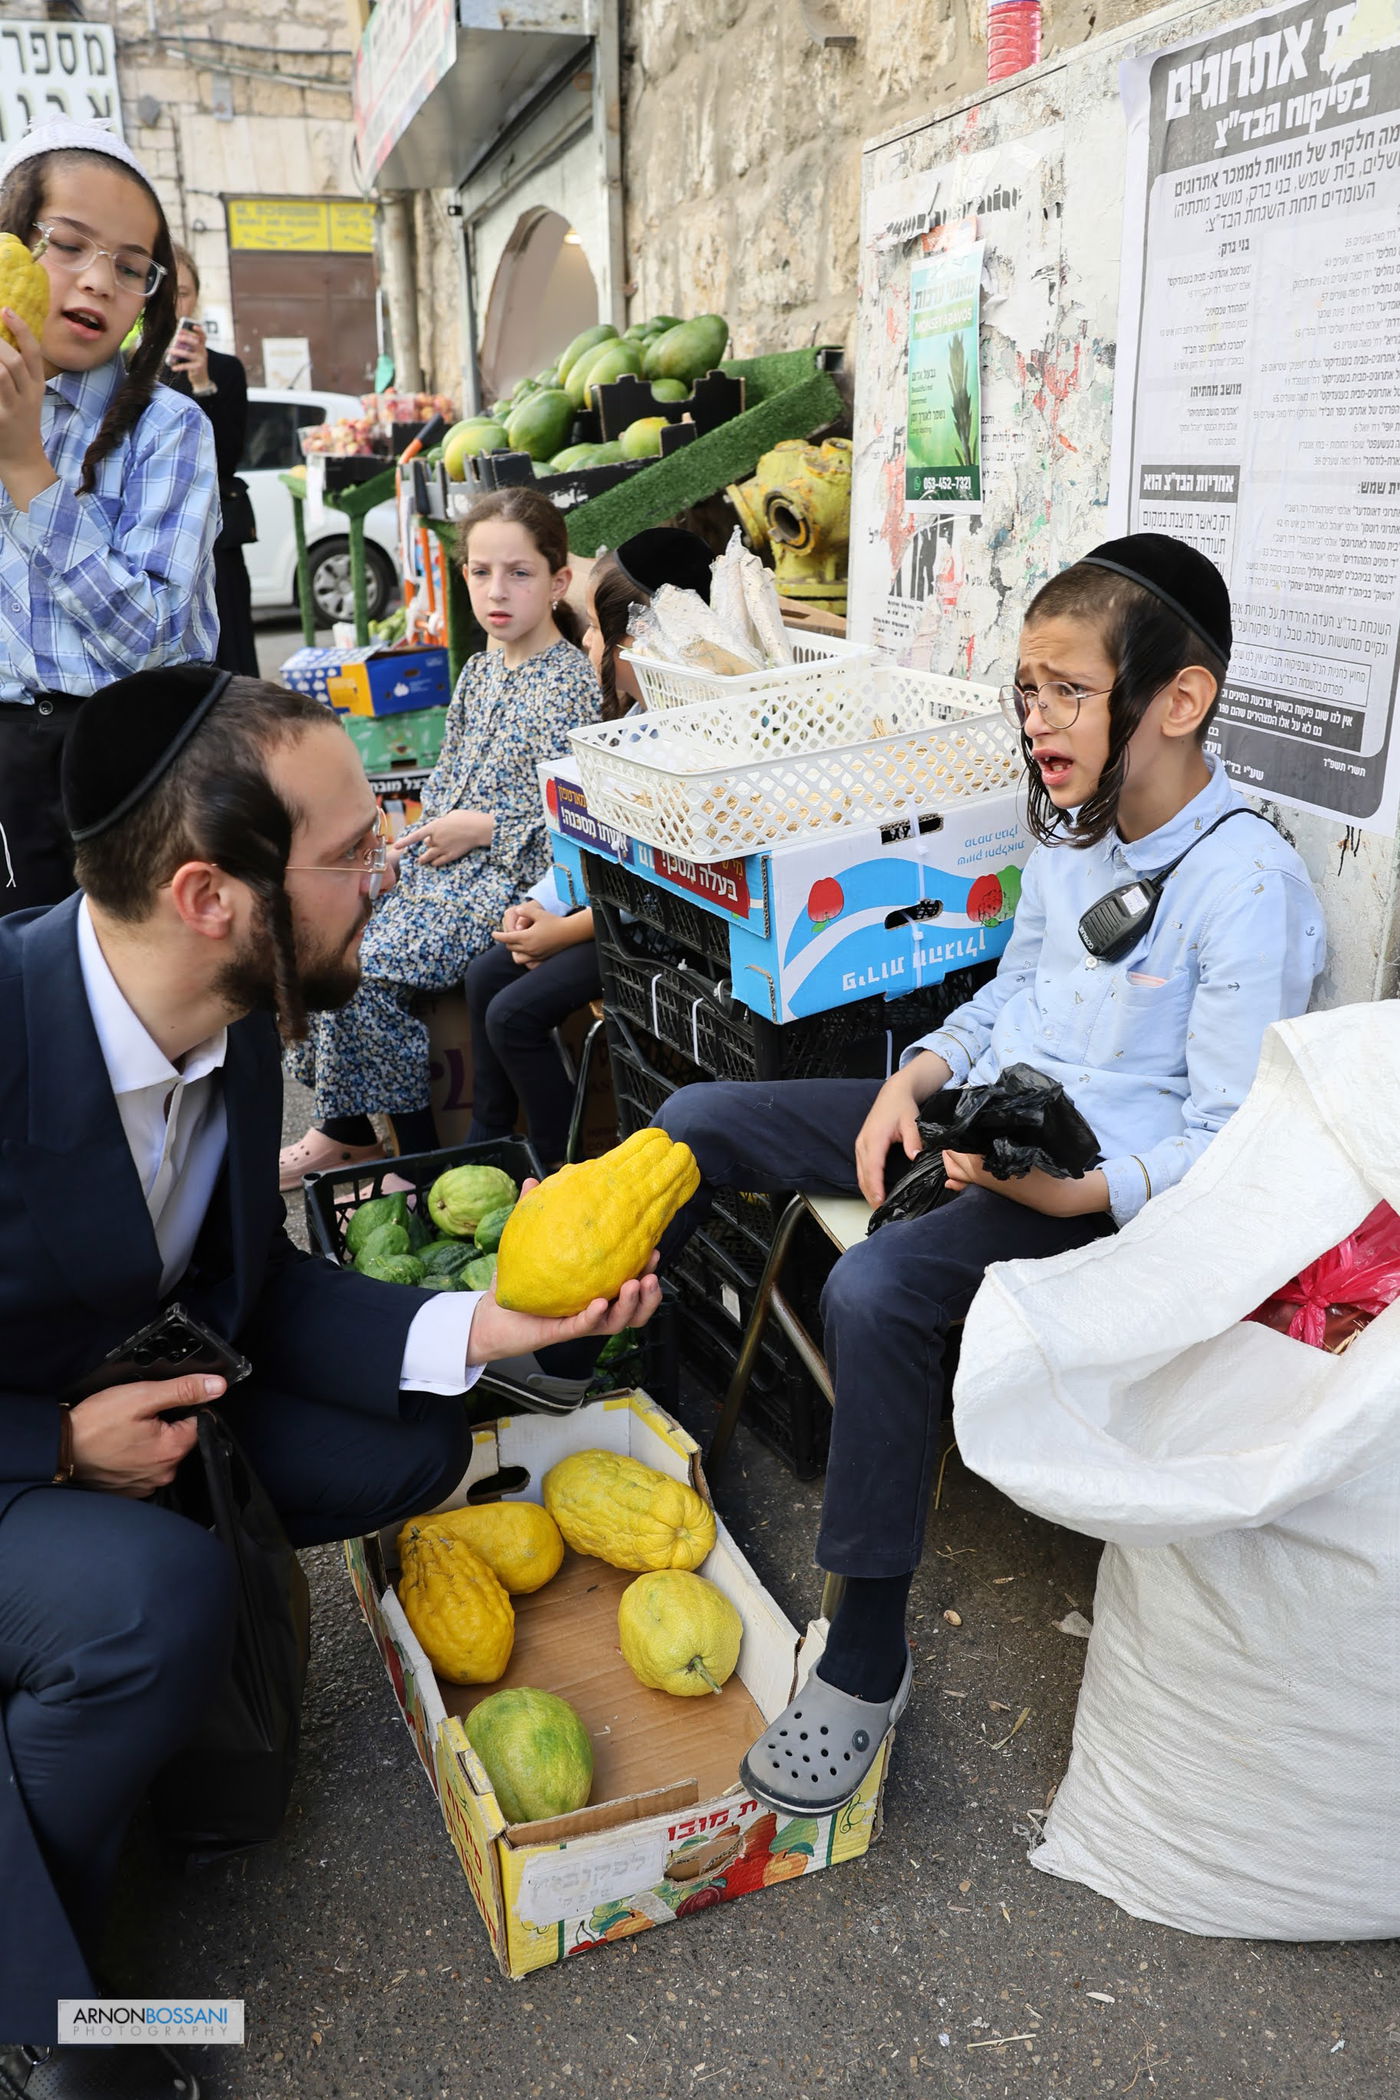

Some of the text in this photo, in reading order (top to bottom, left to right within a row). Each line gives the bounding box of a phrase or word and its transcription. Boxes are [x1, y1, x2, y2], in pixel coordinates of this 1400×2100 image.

[1166, 18, 1314, 121] אתרוגים
[1214, 74, 1371, 149] בפיקוח הבד"צ
[1307, 142, 1326, 164] של
[1330, 129, 1374, 160] חלקית
[1223, 155, 1260, 183] לממכר
[1265, 151, 1302, 175] חנויות
[1333, 162, 1354, 181] בית
[1175, 174, 1218, 197] אתרוגים
[1276, 179, 1290, 194] בני
[1214, 189, 1242, 209] מושב
[1289, 192, 1316, 213] תחת
[1321, 182, 1375, 208] העומדים
[1174, 195, 1210, 218] מתתיהו
[1245, 200, 1285, 222] השגחת
[1240, 239, 1249, 251] בני
[1220, 384, 1242, 395] מושב
[924, 476, 971, 490] 053-452-7321
[1143, 472, 1234, 492] אחריות הבד"צ הוא
[1269, 605, 1277, 620] על
[1312, 610, 1334, 628] העדה
[1360, 617, 1392, 636] השגחת
[1250, 695, 1272, 709] ארבעת
[1273, 699, 1293, 713] בשוקי
[1246, 709, 1277, 724] המצהירים
[1294, 705, 1314, 720] פיקוח
[1314, 709, 1329, 722] שום
[1290, 718, 1301, 732] על
[1301, 721, 1312, 734] לא
[1341, 714, 1353, 730] אין
[1313, 726, 1322, 737] גם
[1348, 764, 1366, 777] תשרי
[995, 824, 1018, 840] הגולן
[699, 864, 738, 902] בעלה
[842, 929, 986, 991] פירות מהגולן
